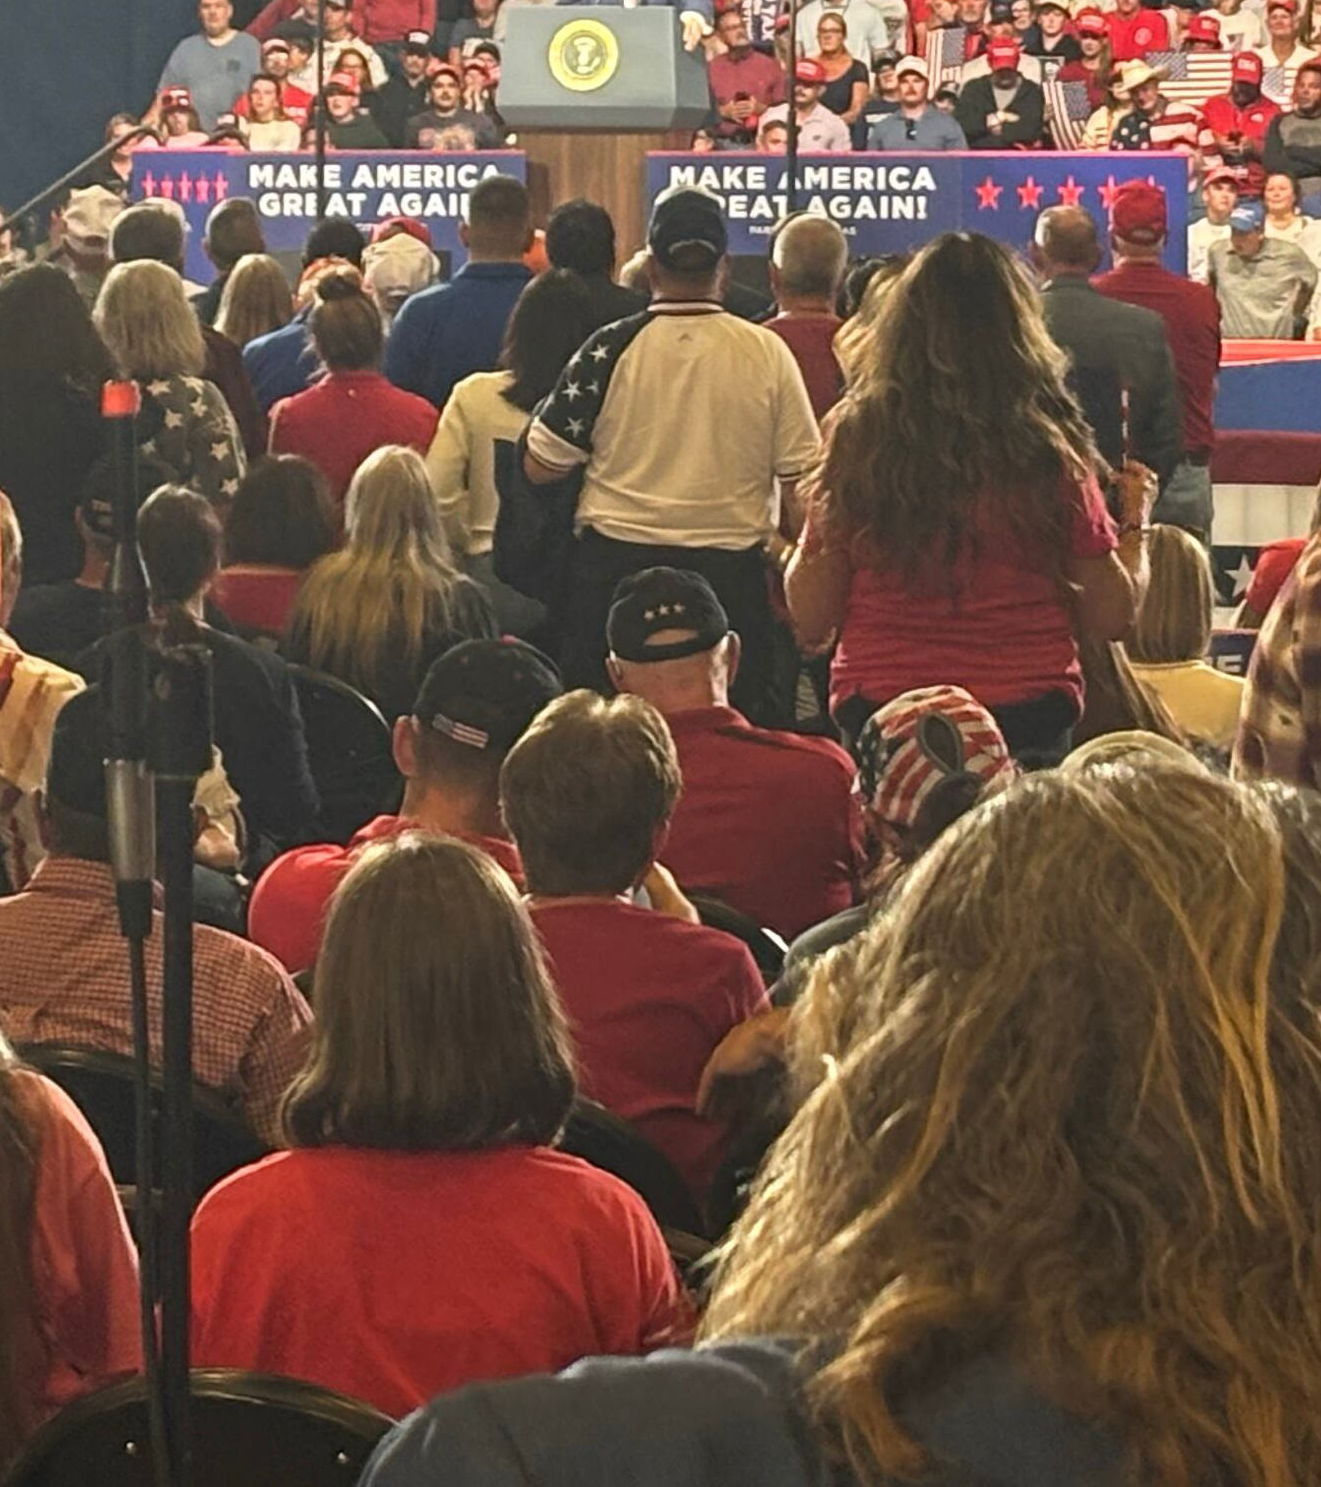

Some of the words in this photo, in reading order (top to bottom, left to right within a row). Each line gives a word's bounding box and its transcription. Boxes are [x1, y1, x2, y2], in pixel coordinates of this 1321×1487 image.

[248, 164, 342, 189] MAKE
[669, 165, 767, 190] MAKE
[259, 192, 367, 217] GREAT
[724, 195, 790, 219] EAT
[806, 194, 928, 220] AGAIN!
